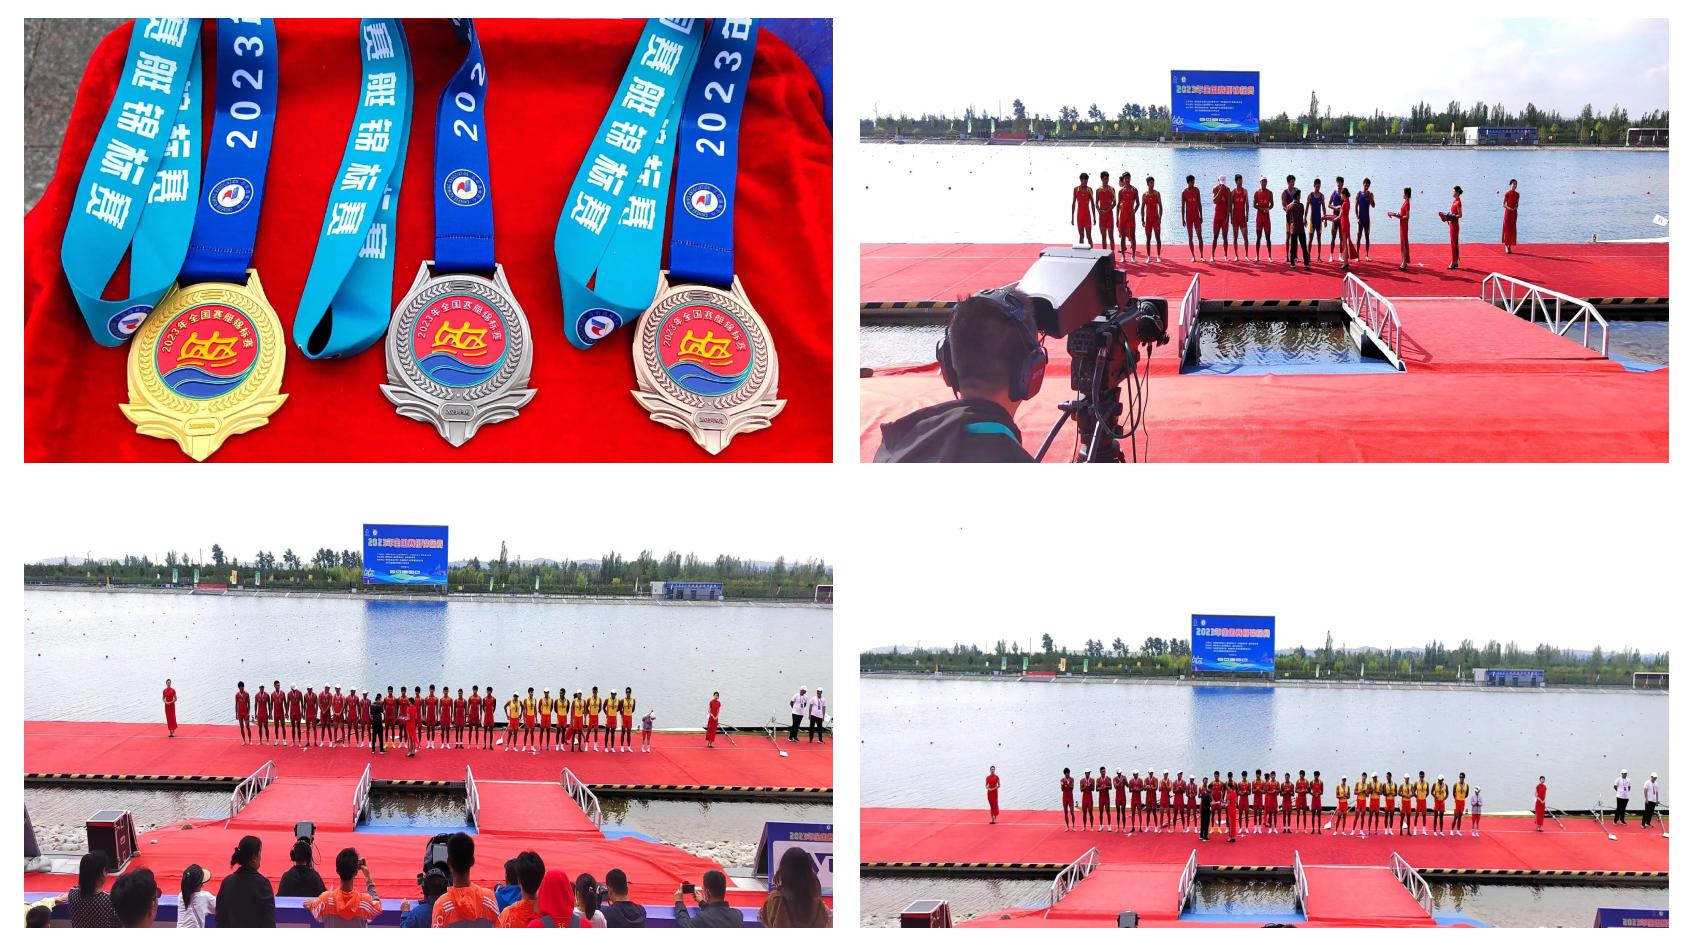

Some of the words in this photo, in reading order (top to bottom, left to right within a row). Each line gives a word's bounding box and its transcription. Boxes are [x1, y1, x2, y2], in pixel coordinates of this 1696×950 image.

[85, 18, 189, 230] 赛艇锦标赛
[226, 18, 263, 149] 2023
[326, 22, 395, 236] 赛艇锦标赛
[161, 309, 254, 352] 2023年全国赛艇锦标赛
[417, 299, 502, 341] 2023年全国赛艇锦标赛
[662, 309, 747, 351] 2023年全国赛艇锦标赛
